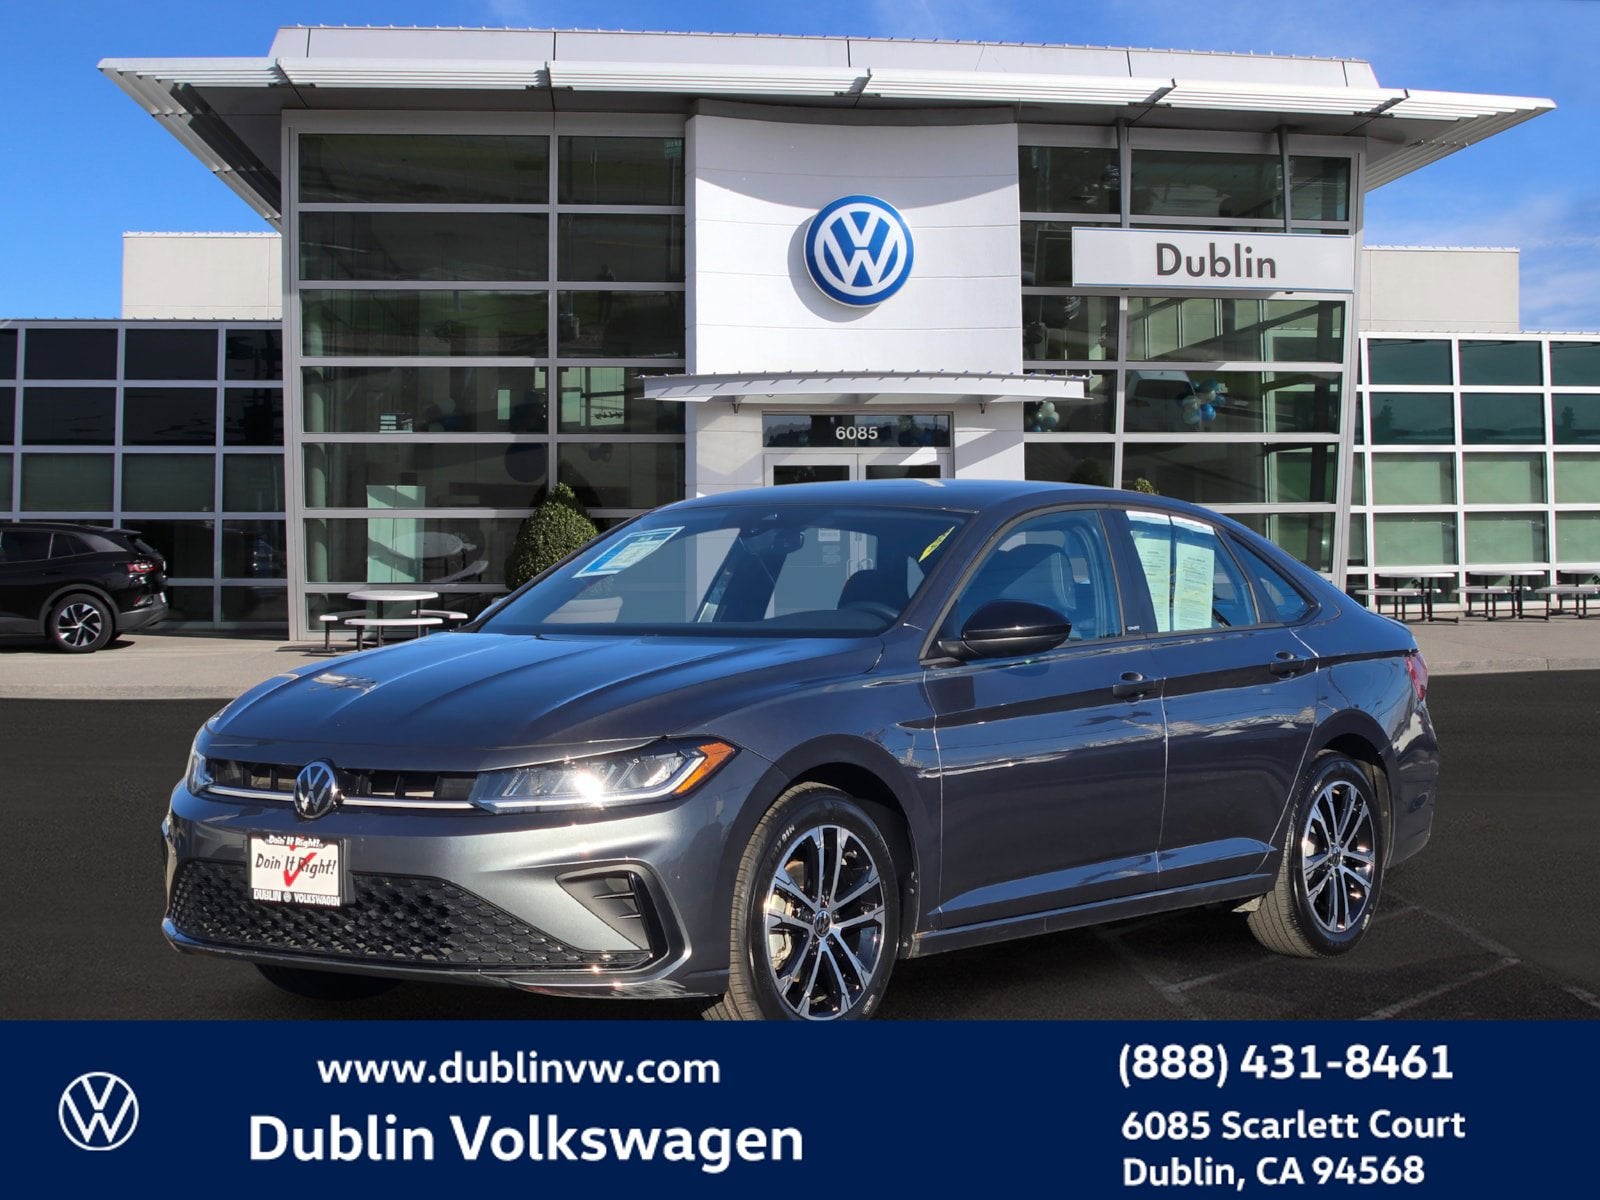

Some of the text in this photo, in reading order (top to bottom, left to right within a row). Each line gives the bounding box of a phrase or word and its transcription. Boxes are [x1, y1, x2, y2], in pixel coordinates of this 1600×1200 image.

[809, 199, 910, 300] VW
[1156, 242, 1276, 279] Dublin
[835, 426, 879, 440] 6085
[285, 855, 295, 872] It
[298, 856, 337, 879] Right!
[253, 889, 282, 902] DUBLIN
[293, 892, 341, 907] VOLKSWAGEN
